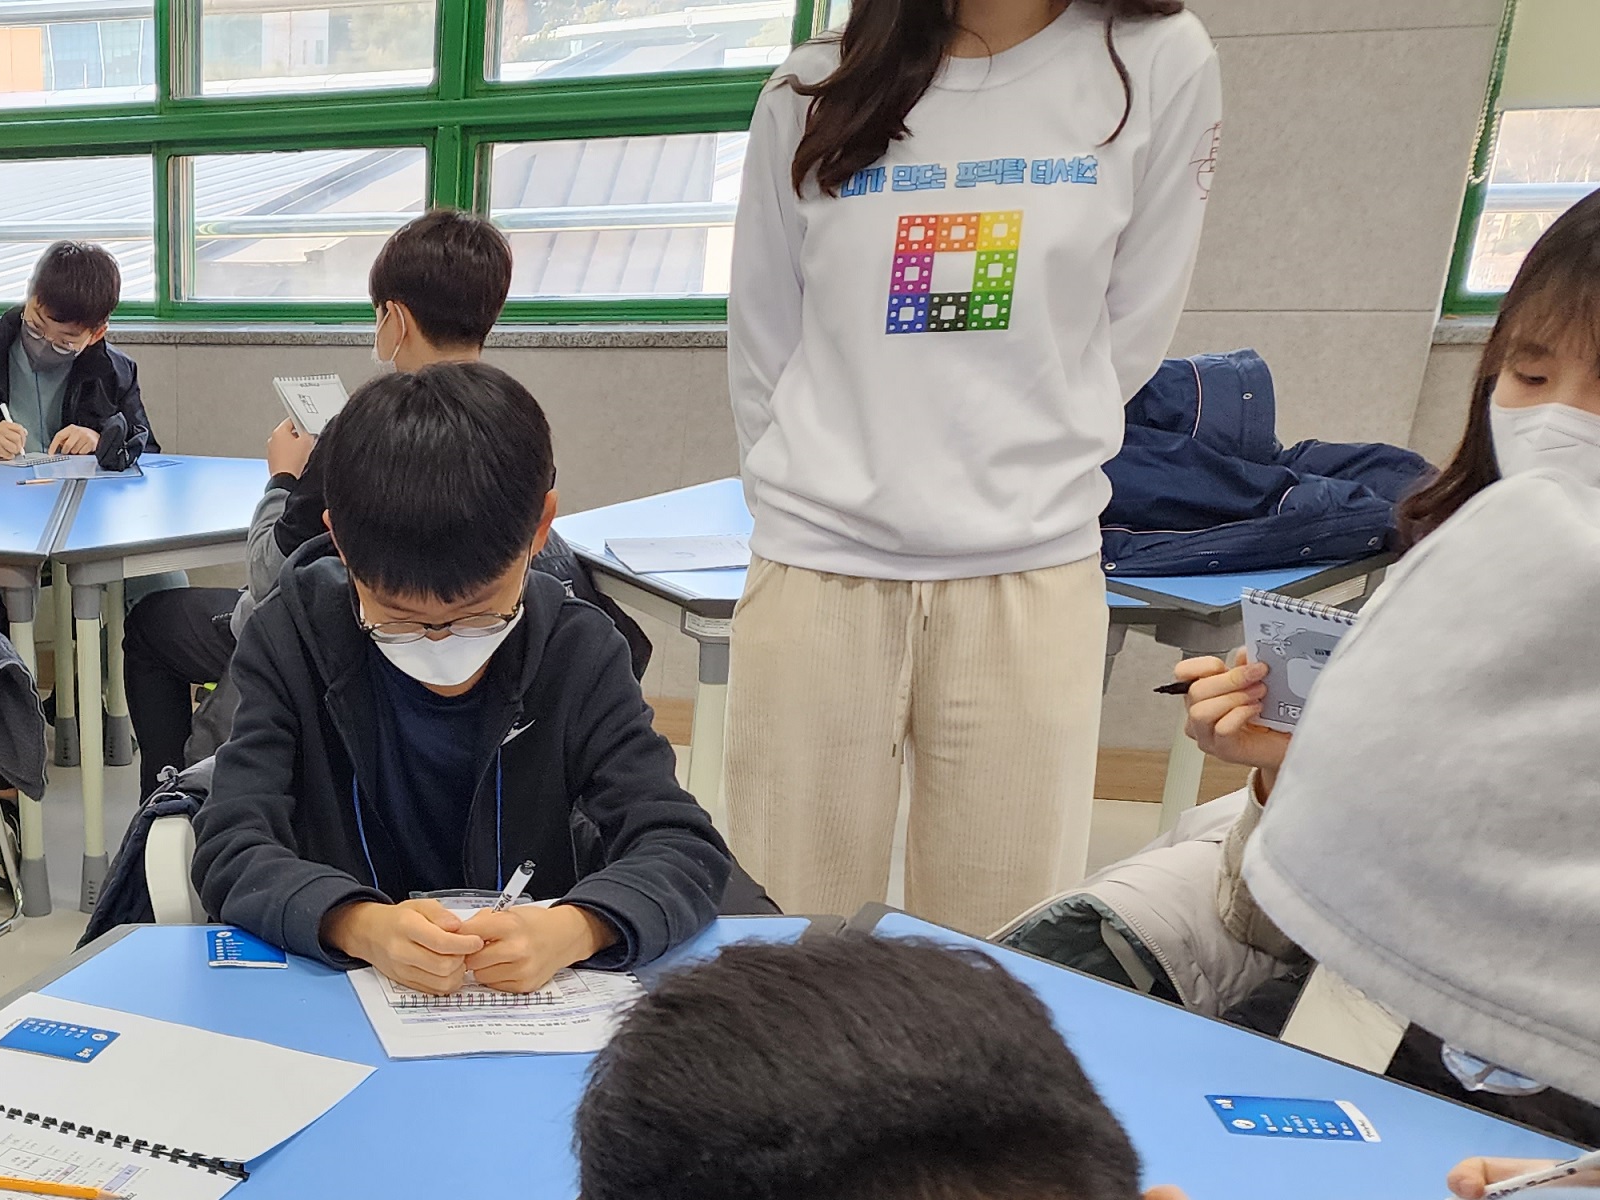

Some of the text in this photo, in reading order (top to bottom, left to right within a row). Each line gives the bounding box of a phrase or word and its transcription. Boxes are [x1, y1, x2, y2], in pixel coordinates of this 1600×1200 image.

[892, 164, 947, 192] 만드는
[955, 158, 1027, 188] 프랙탈
[1030, 155, 1098, 185] 티셔츠
